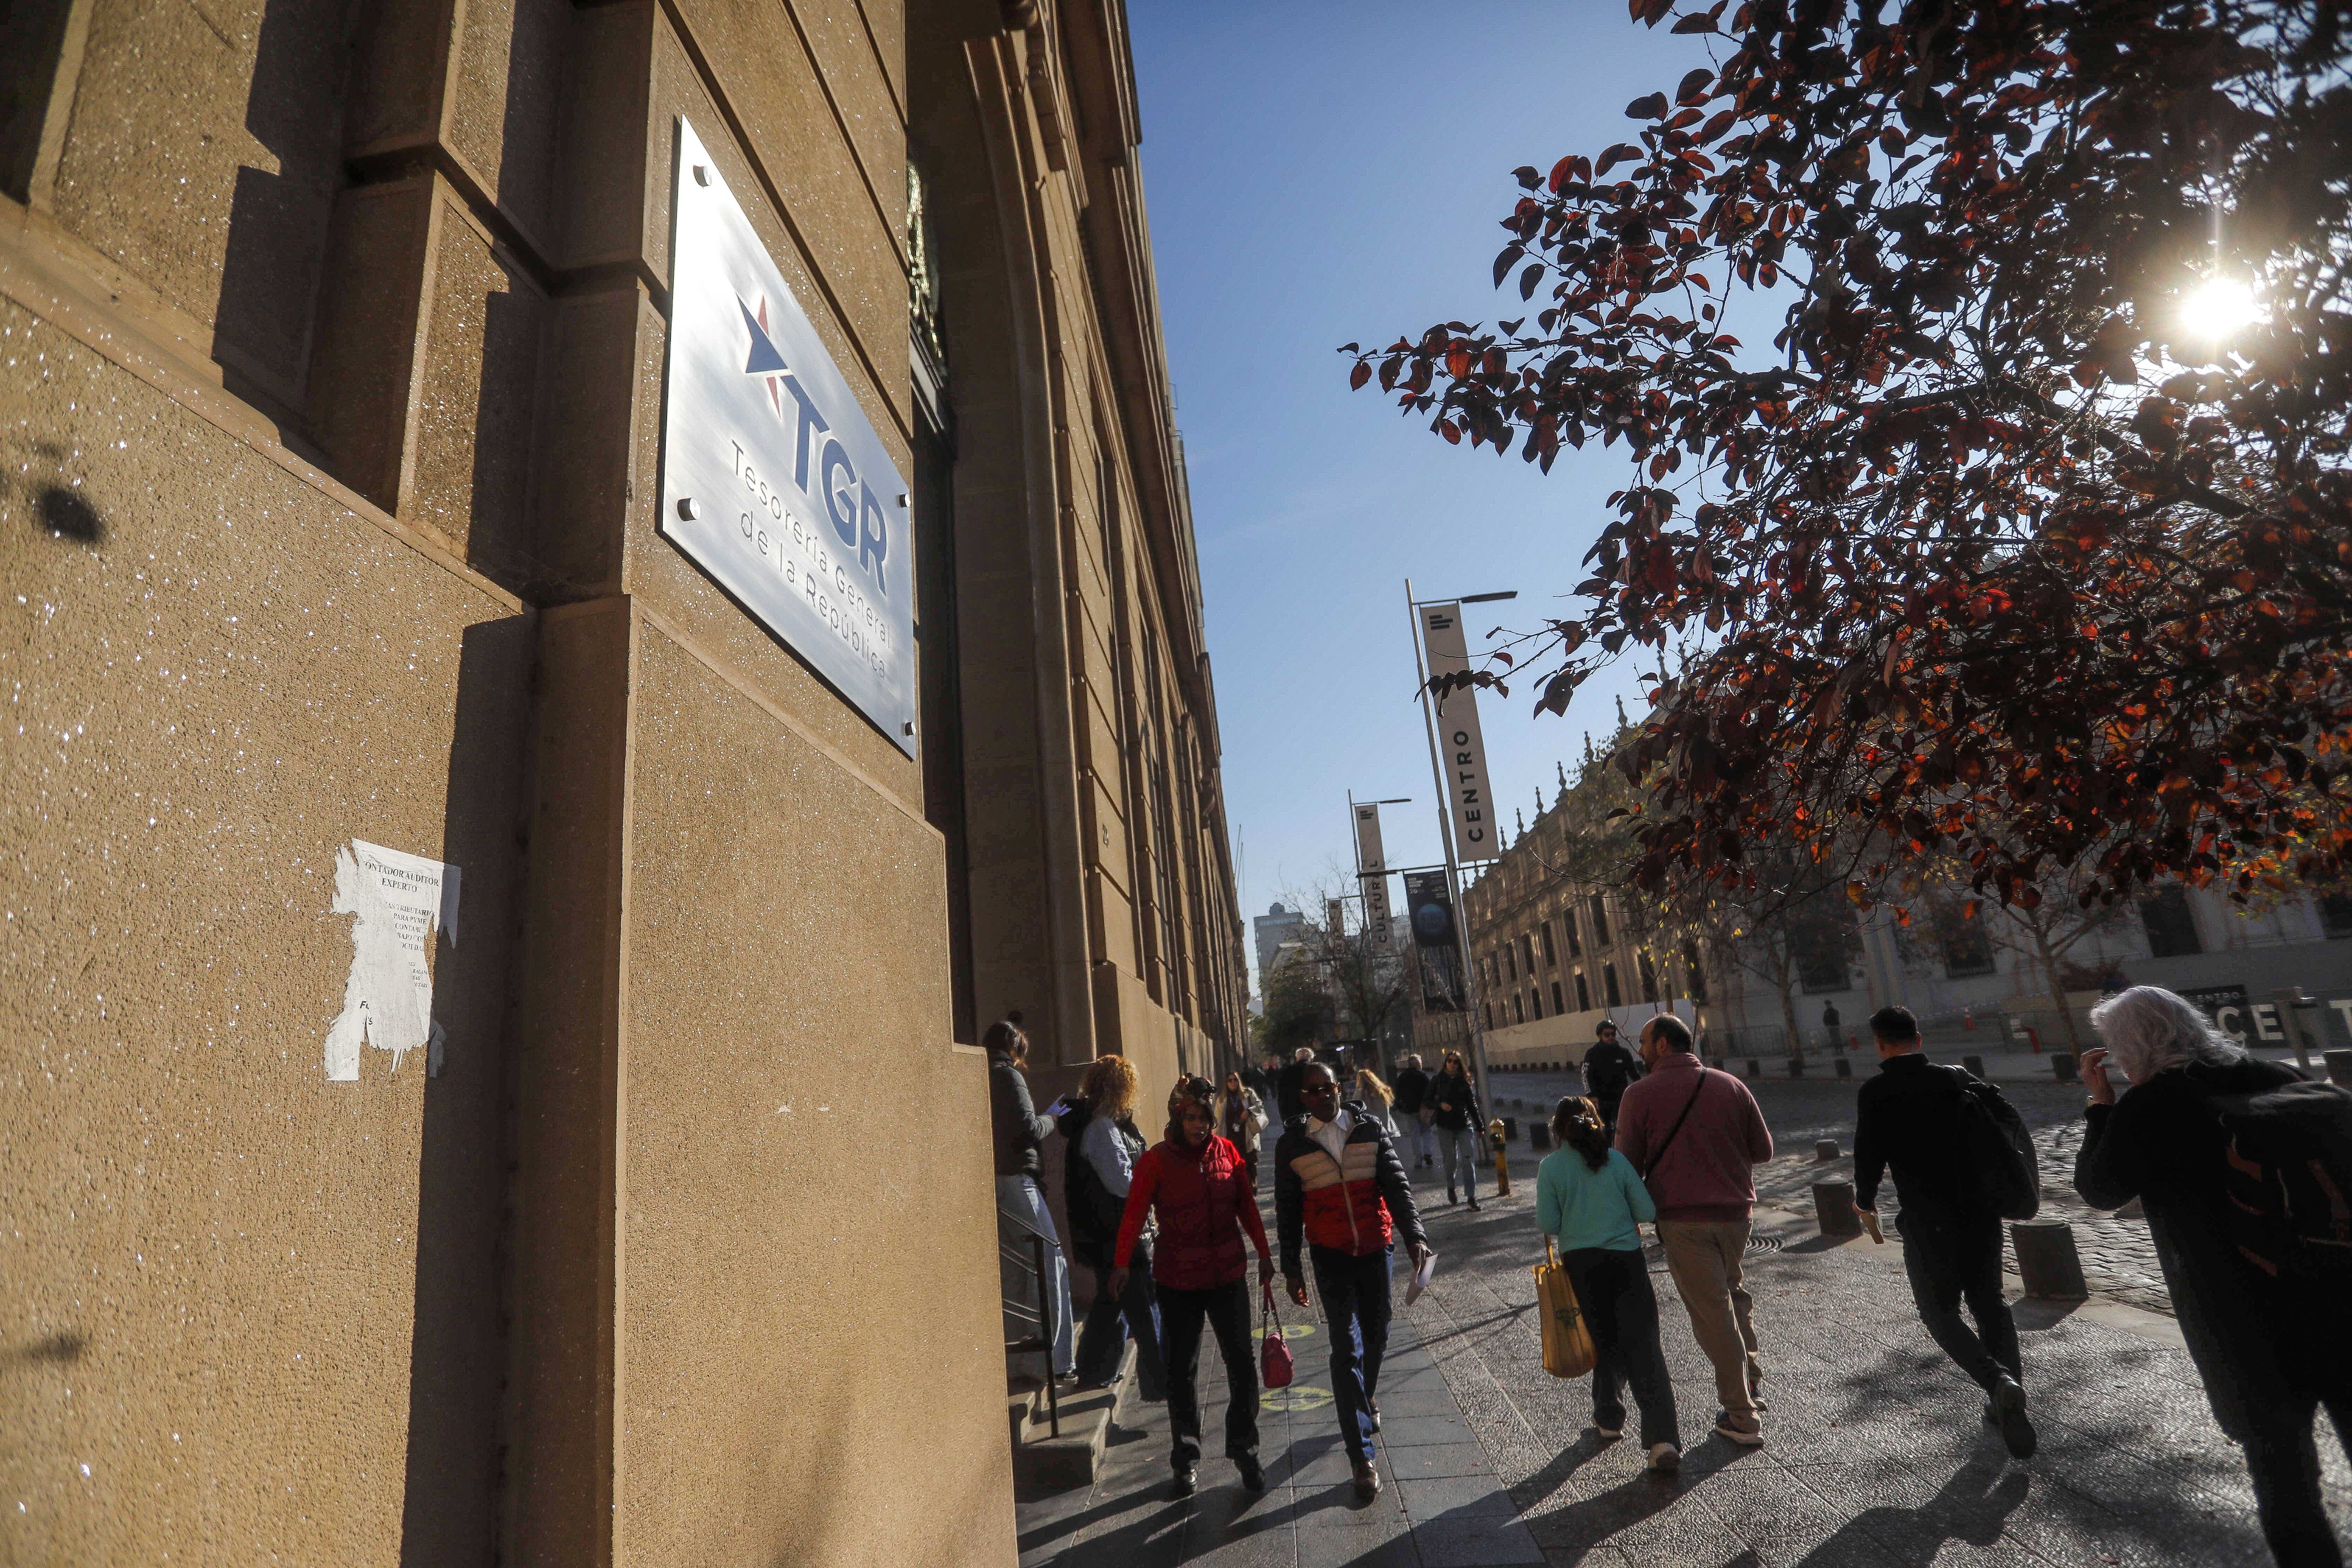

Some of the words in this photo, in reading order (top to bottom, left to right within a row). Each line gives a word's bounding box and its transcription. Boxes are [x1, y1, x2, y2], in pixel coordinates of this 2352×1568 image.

[780, 374, 886, 597] TGR
[731, 438, 826, 575] Tesorería
[836, 565, 890, 649] General
[741, 510, 768, 556] de
[780, 542, 795, 586] la
[806, 572, 885, 681] República
[1453, 730, 1485, 843] CENTRO
[365, 861, 404, 878] ONTADOR
[405, 872, 440, 886] AUDITOR
[381, 877, 417, 892] EXPERTO
[393, 913, 409, 922] PARA
[1369, 860, 1387, 943] CULTURL
